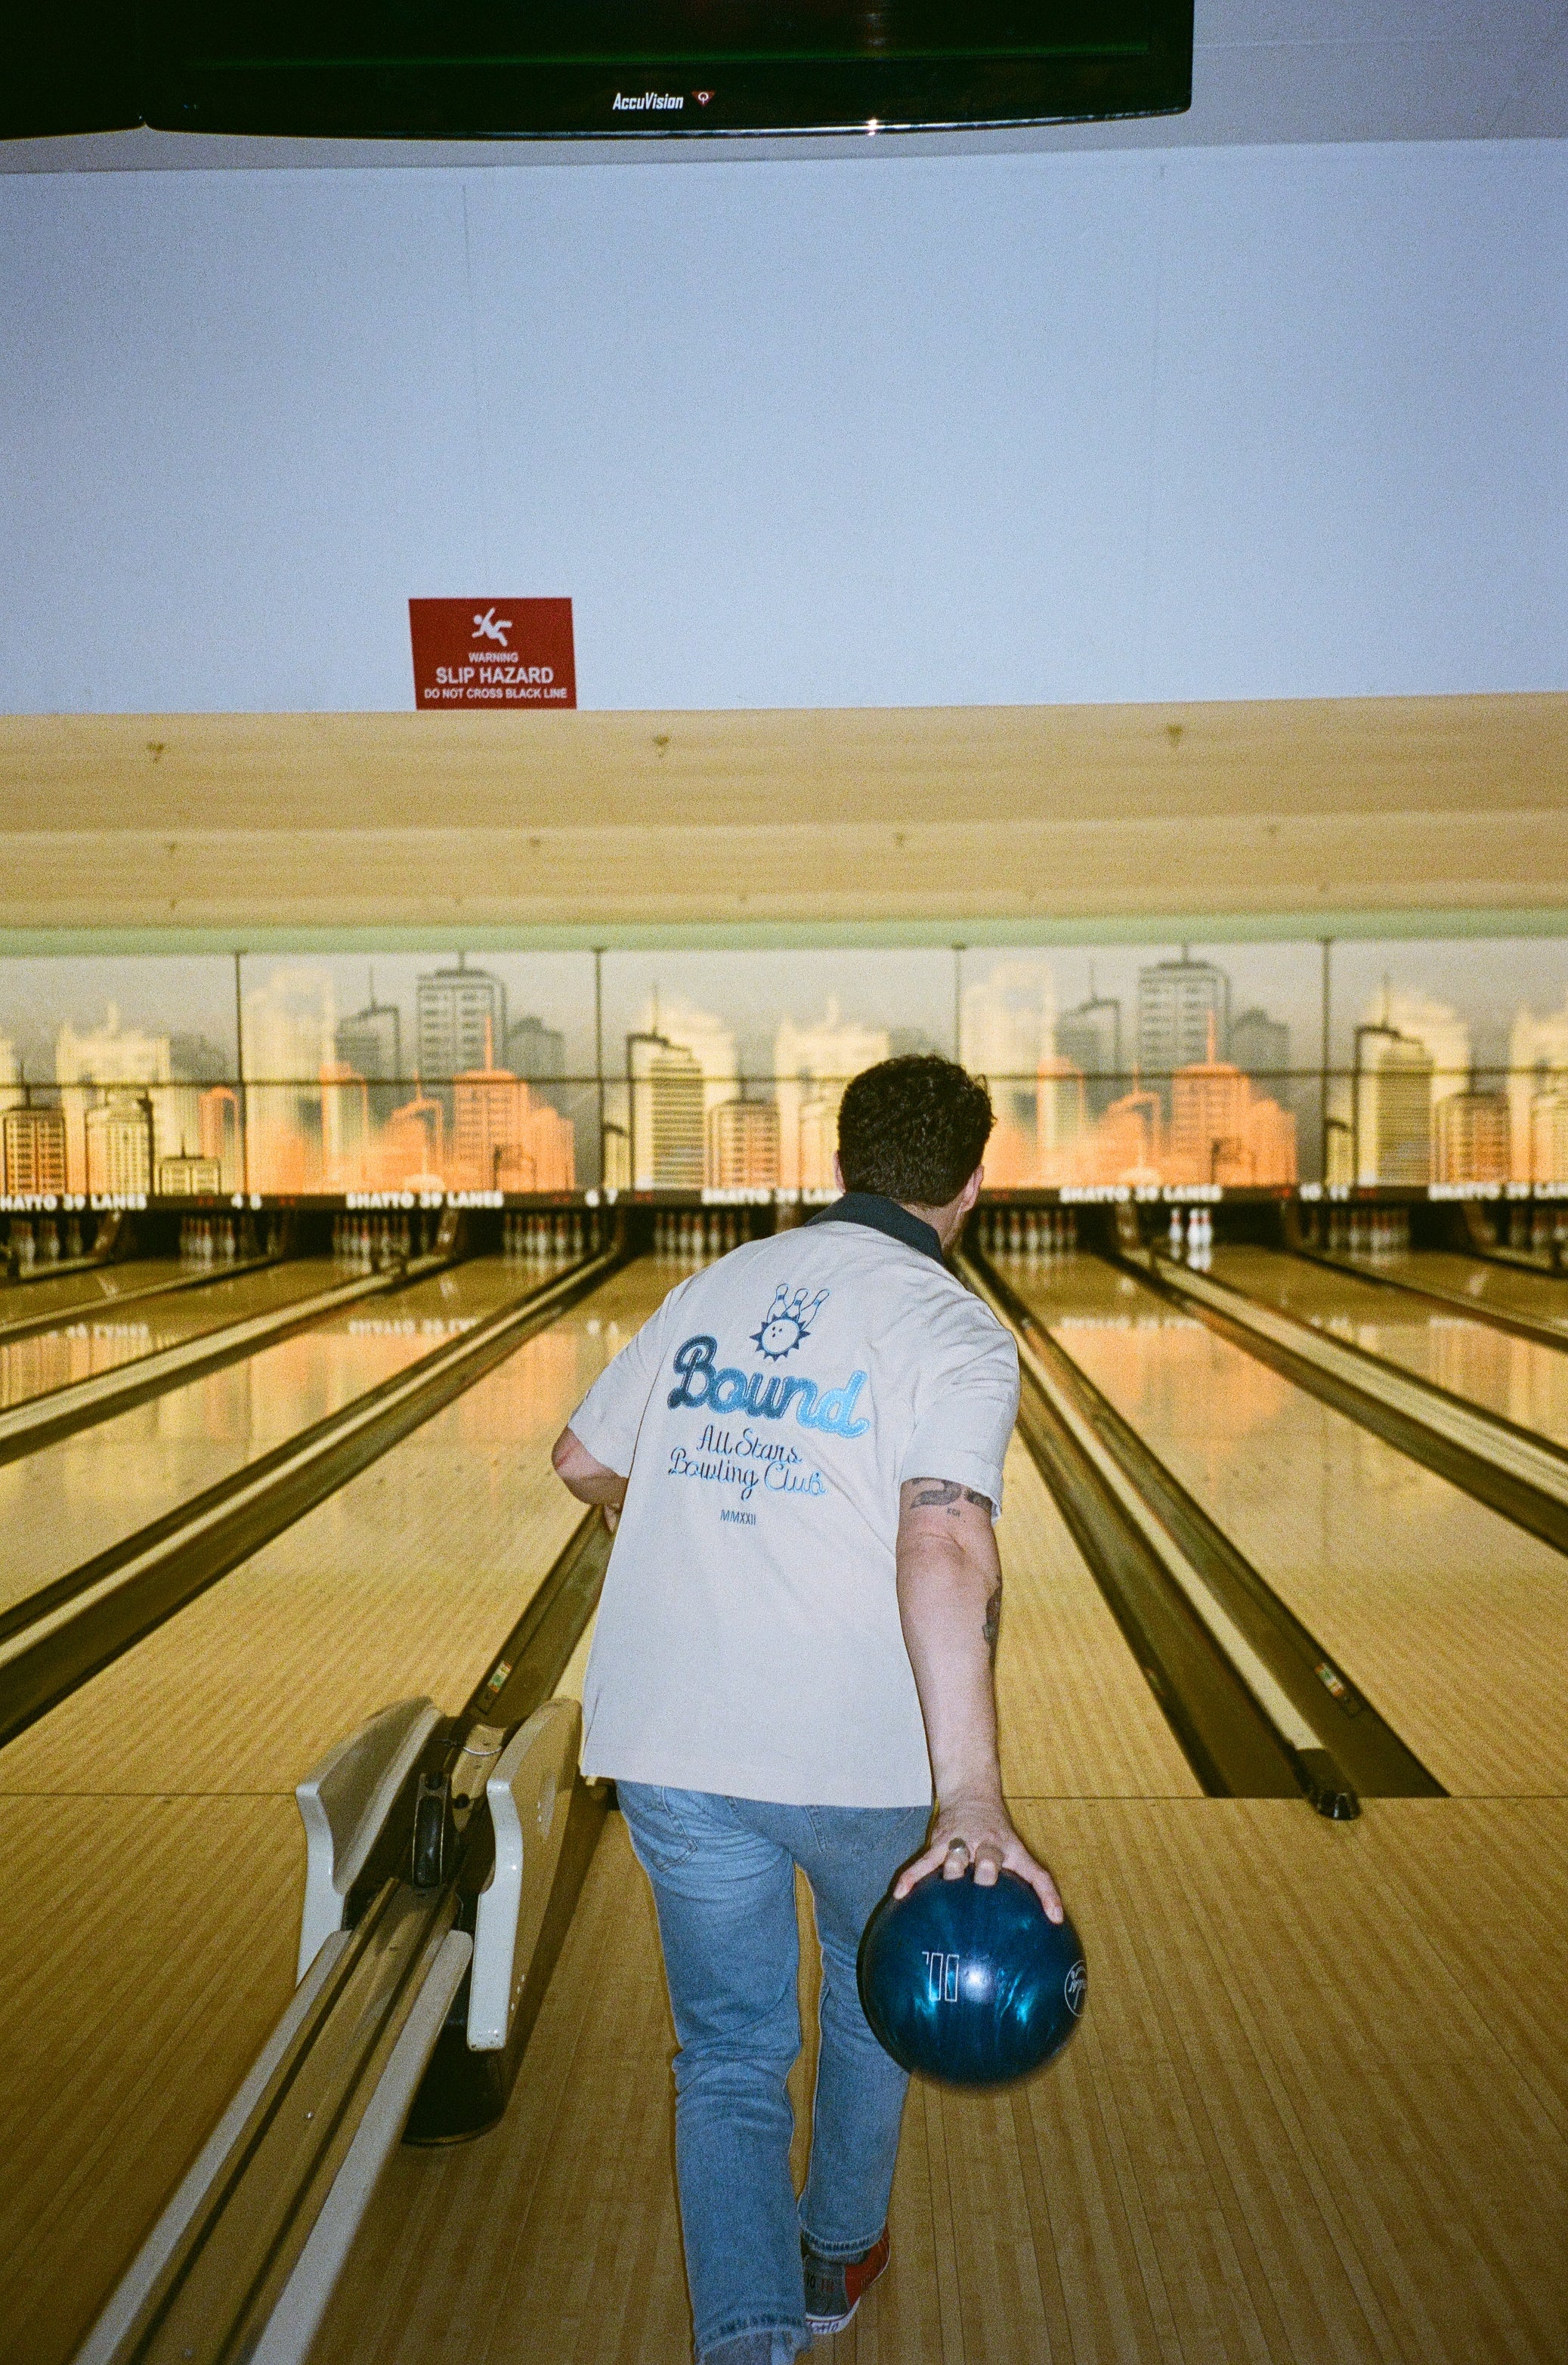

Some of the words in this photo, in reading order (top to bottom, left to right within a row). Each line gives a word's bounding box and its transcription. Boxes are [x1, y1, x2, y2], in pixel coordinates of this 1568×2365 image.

[613, 91, 684, 110] AccuVision
[469, 652, 519, 663] WARNING
[436, 667, 475, 684] SLIP
[480, 666, 553, 684] HAZARD
[425, 688, 440, 699] DO
[443, 688, 463, 699] NOT
[467, 688, 503, 699] CROSS
[506, 688, 541, 699] BLACK
[544, 688, 568, 699] LINE
[230, 1193, 243, 1209] 4
[667, 1334, 871, 1439] Bound
[697, 1424, 733, 1457] All
[735, 1428, 802, 1464] Stars
[668, 1446, 759, 1501] Bowling
[764, 1461, 827, 1496] Club
